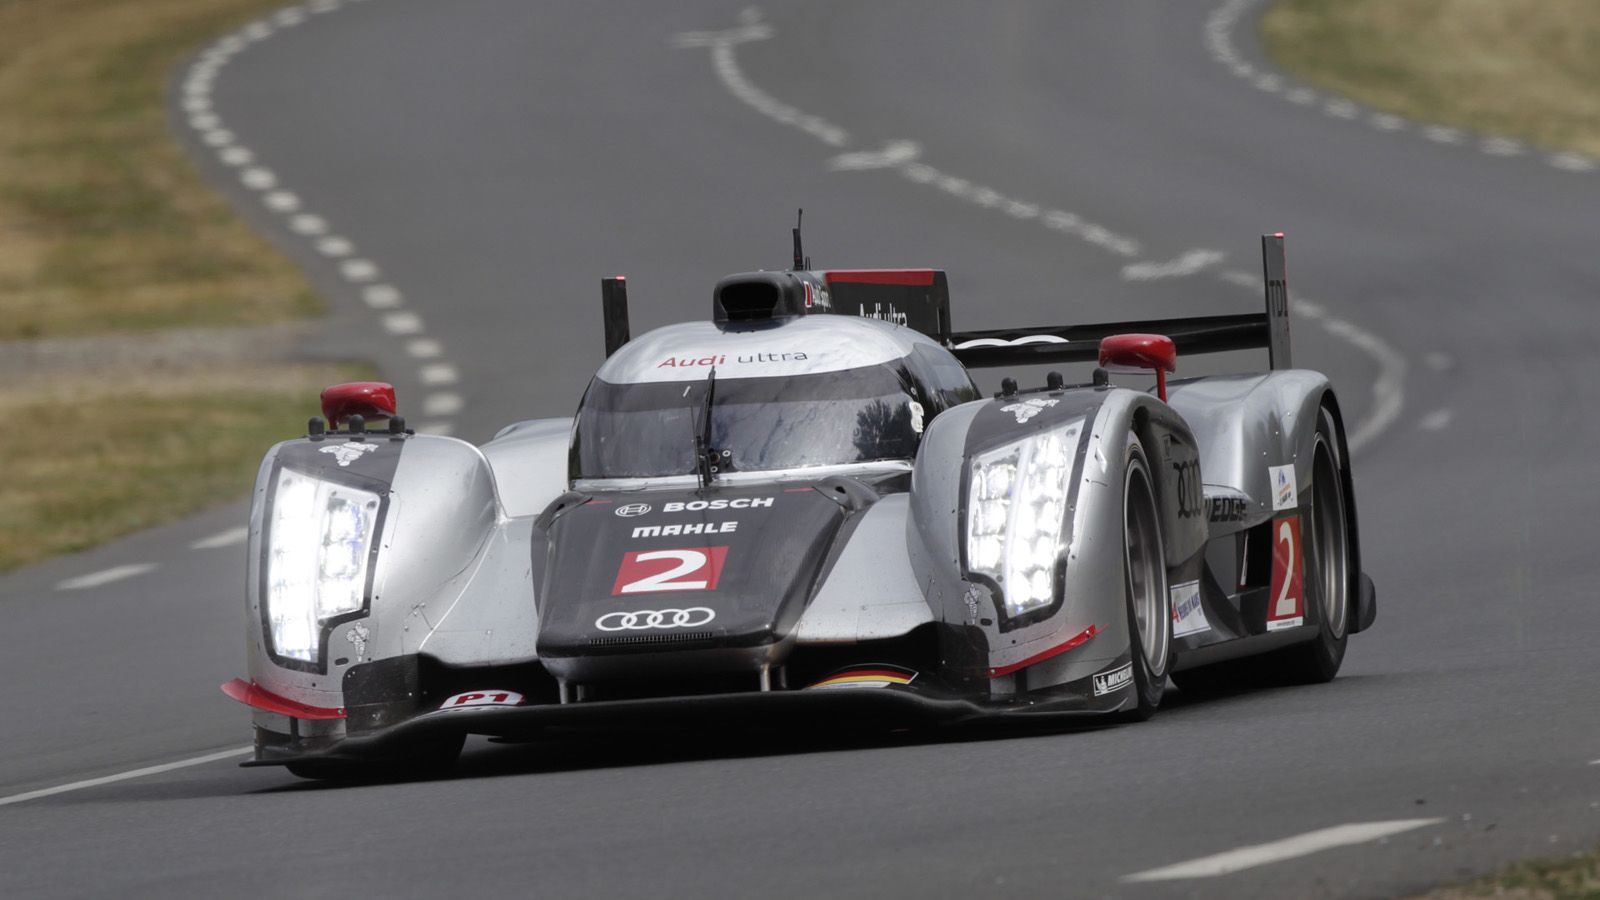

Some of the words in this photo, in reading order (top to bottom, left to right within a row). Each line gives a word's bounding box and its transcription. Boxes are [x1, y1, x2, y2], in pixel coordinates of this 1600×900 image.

[1269, 279, 1289, 318] TDI
[658, 355, 727, 368] Audi
[737, 351, 808, 364] ultra
[663, 498, 775, 512] BOSCH
[631, 521, 738, 538] MAHLE
[620, 549, 708, 594] 2
[1276, 521, 1297, 617] 2
[453, 693, 510, 705] P1
